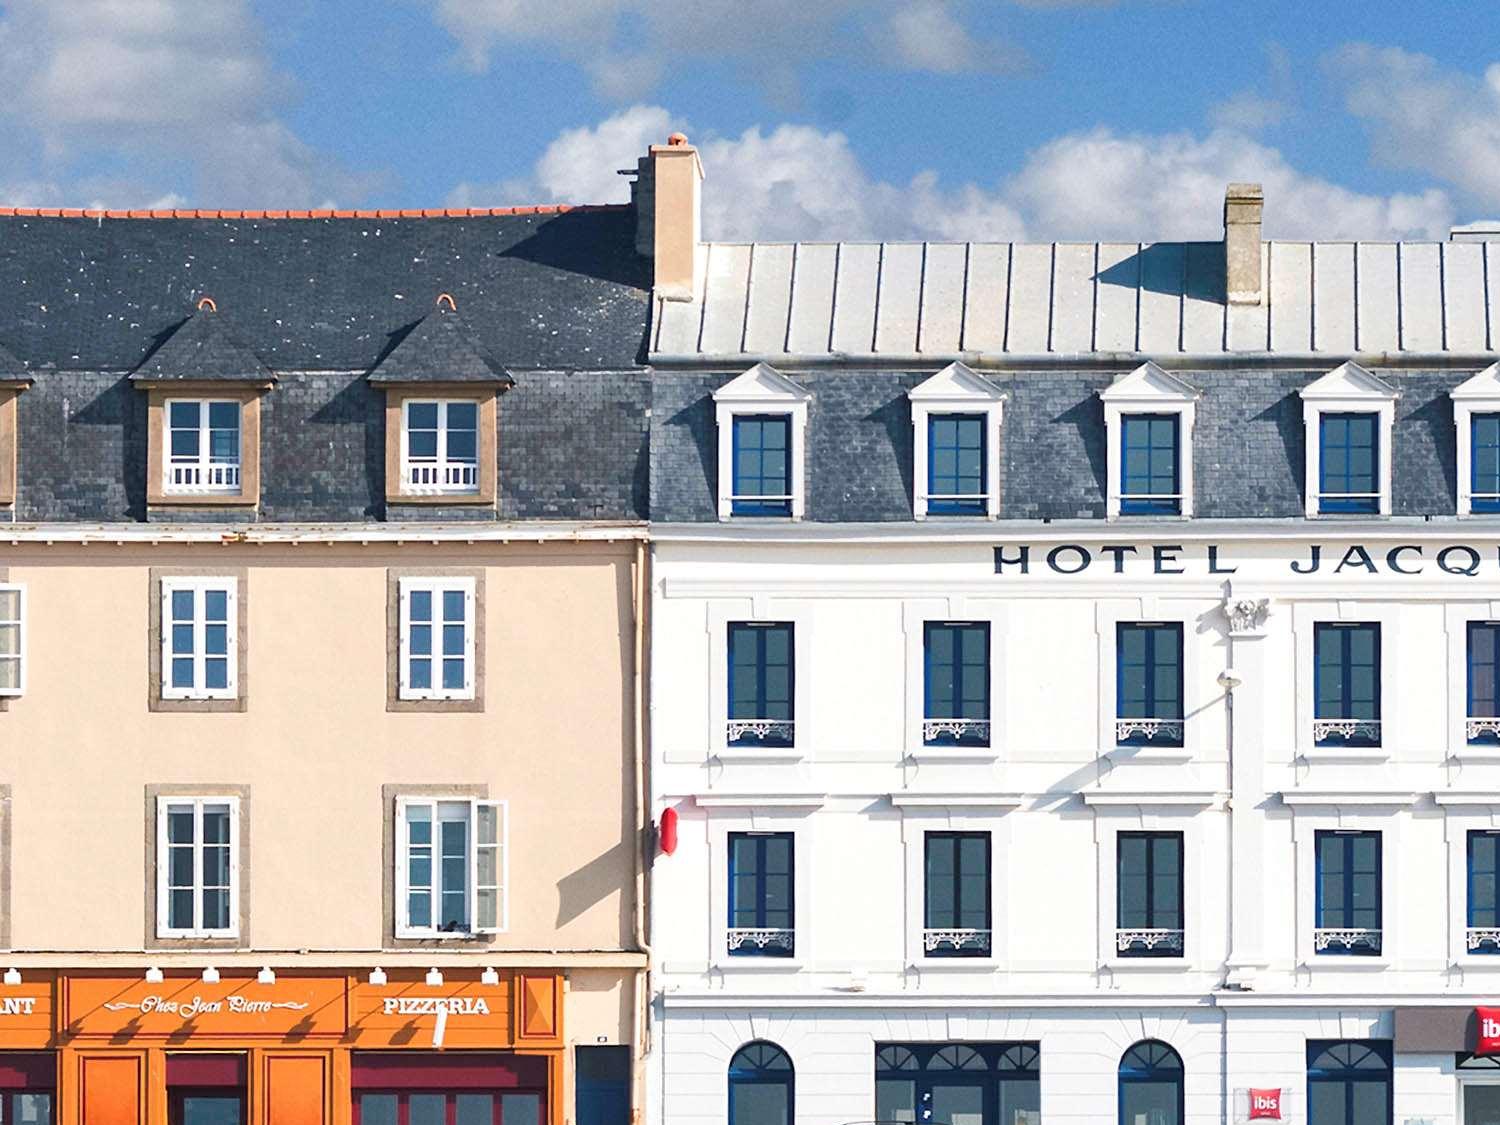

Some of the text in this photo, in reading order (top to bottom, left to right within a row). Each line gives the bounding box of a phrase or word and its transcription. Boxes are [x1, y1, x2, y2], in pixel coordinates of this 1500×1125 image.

[992, 544, 1238, 574] HOTEL
[0, 997, 36, 1014] NT
[140, 995, 271, 1018] Chez Jean Pierre
[383, 997, 490, 1015] PIZZERIA
[1254, 1096, 1277, 1110] ibis
